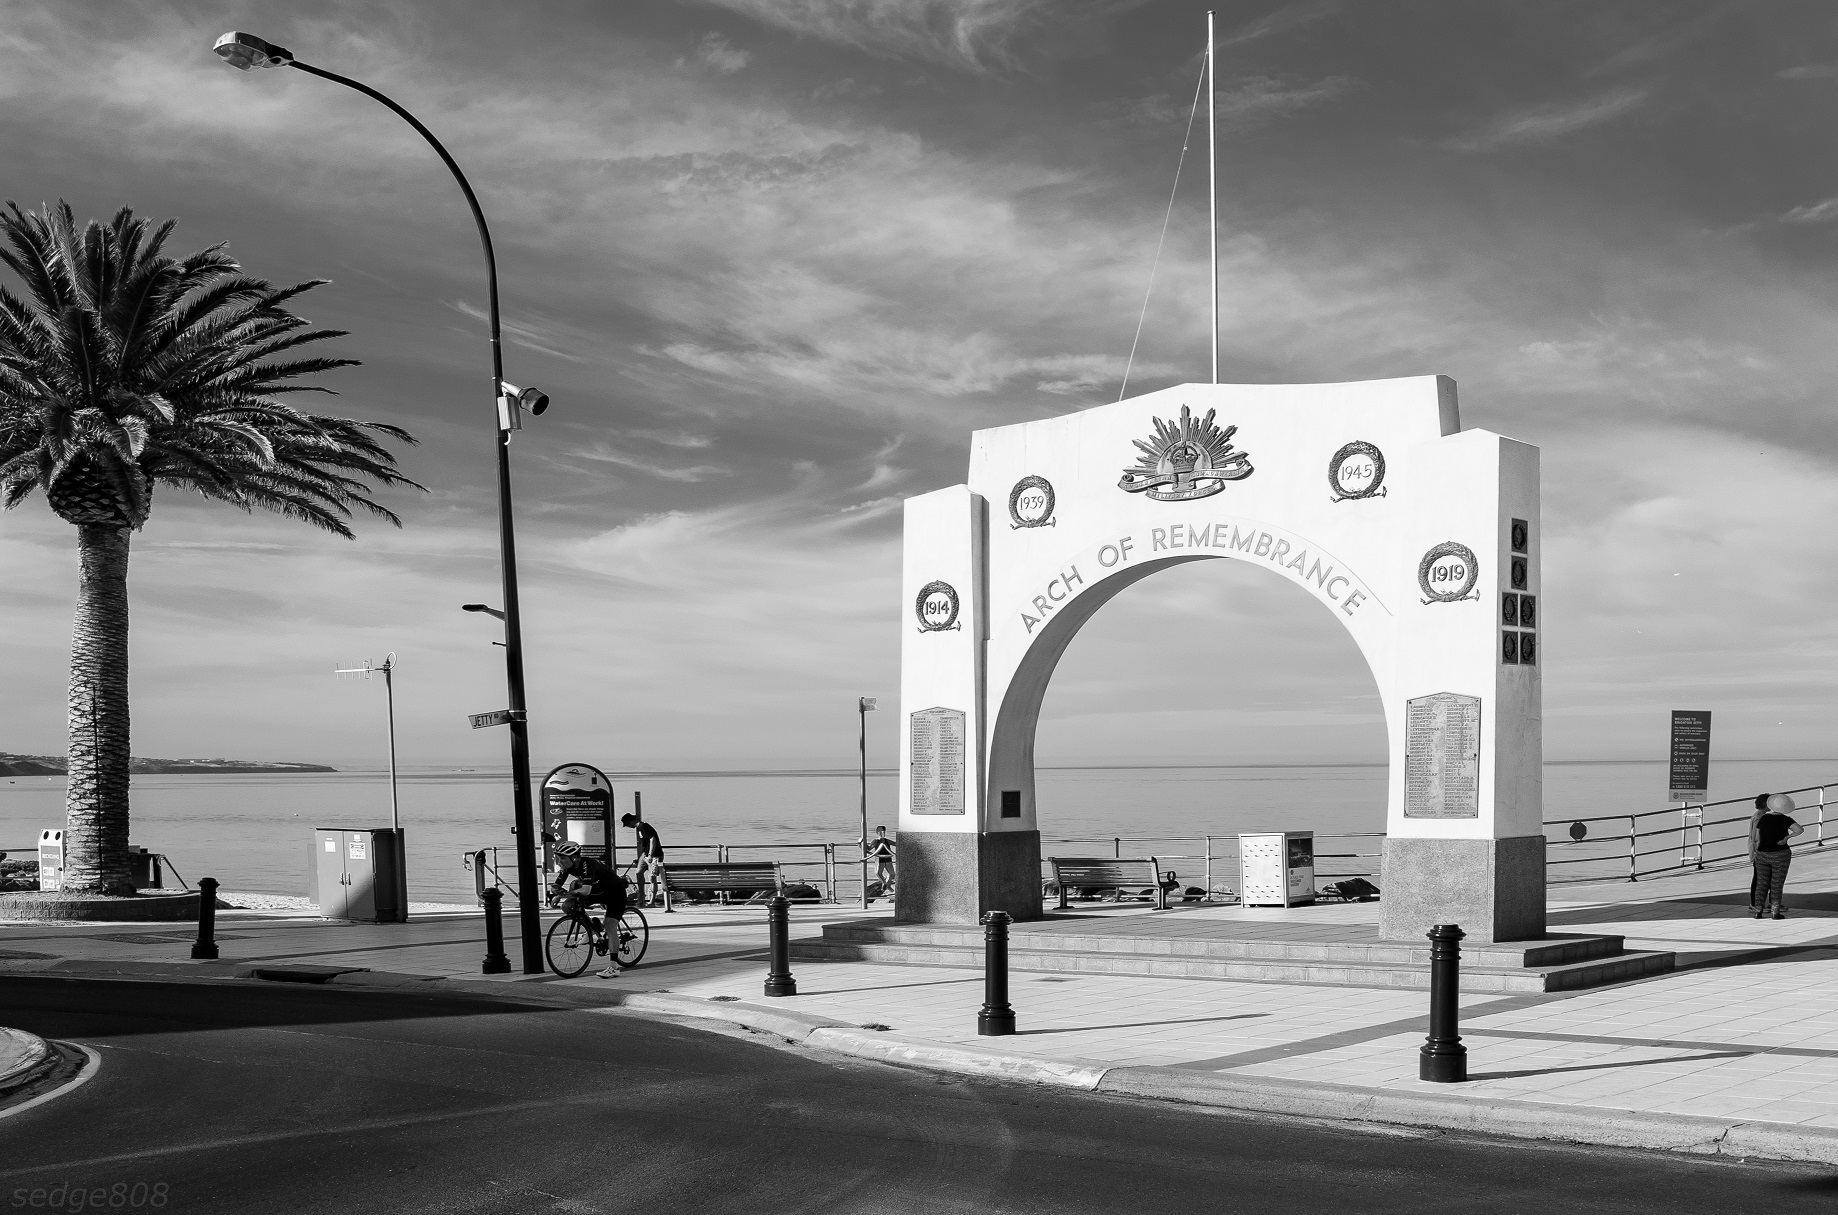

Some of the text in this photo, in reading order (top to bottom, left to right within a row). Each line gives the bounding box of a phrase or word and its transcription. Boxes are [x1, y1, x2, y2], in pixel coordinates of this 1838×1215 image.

[1341, 464, 1373, 480] 1945
[1020, 495, 1044, 511] 1939
[1021, 522, 1367, 634] ARCH OF REMEMBRANCE
[1431, 564, 1465, 582] 1919
[924, 600, 949, 615] 1914
[473, 714, 493, 727] JETTY
